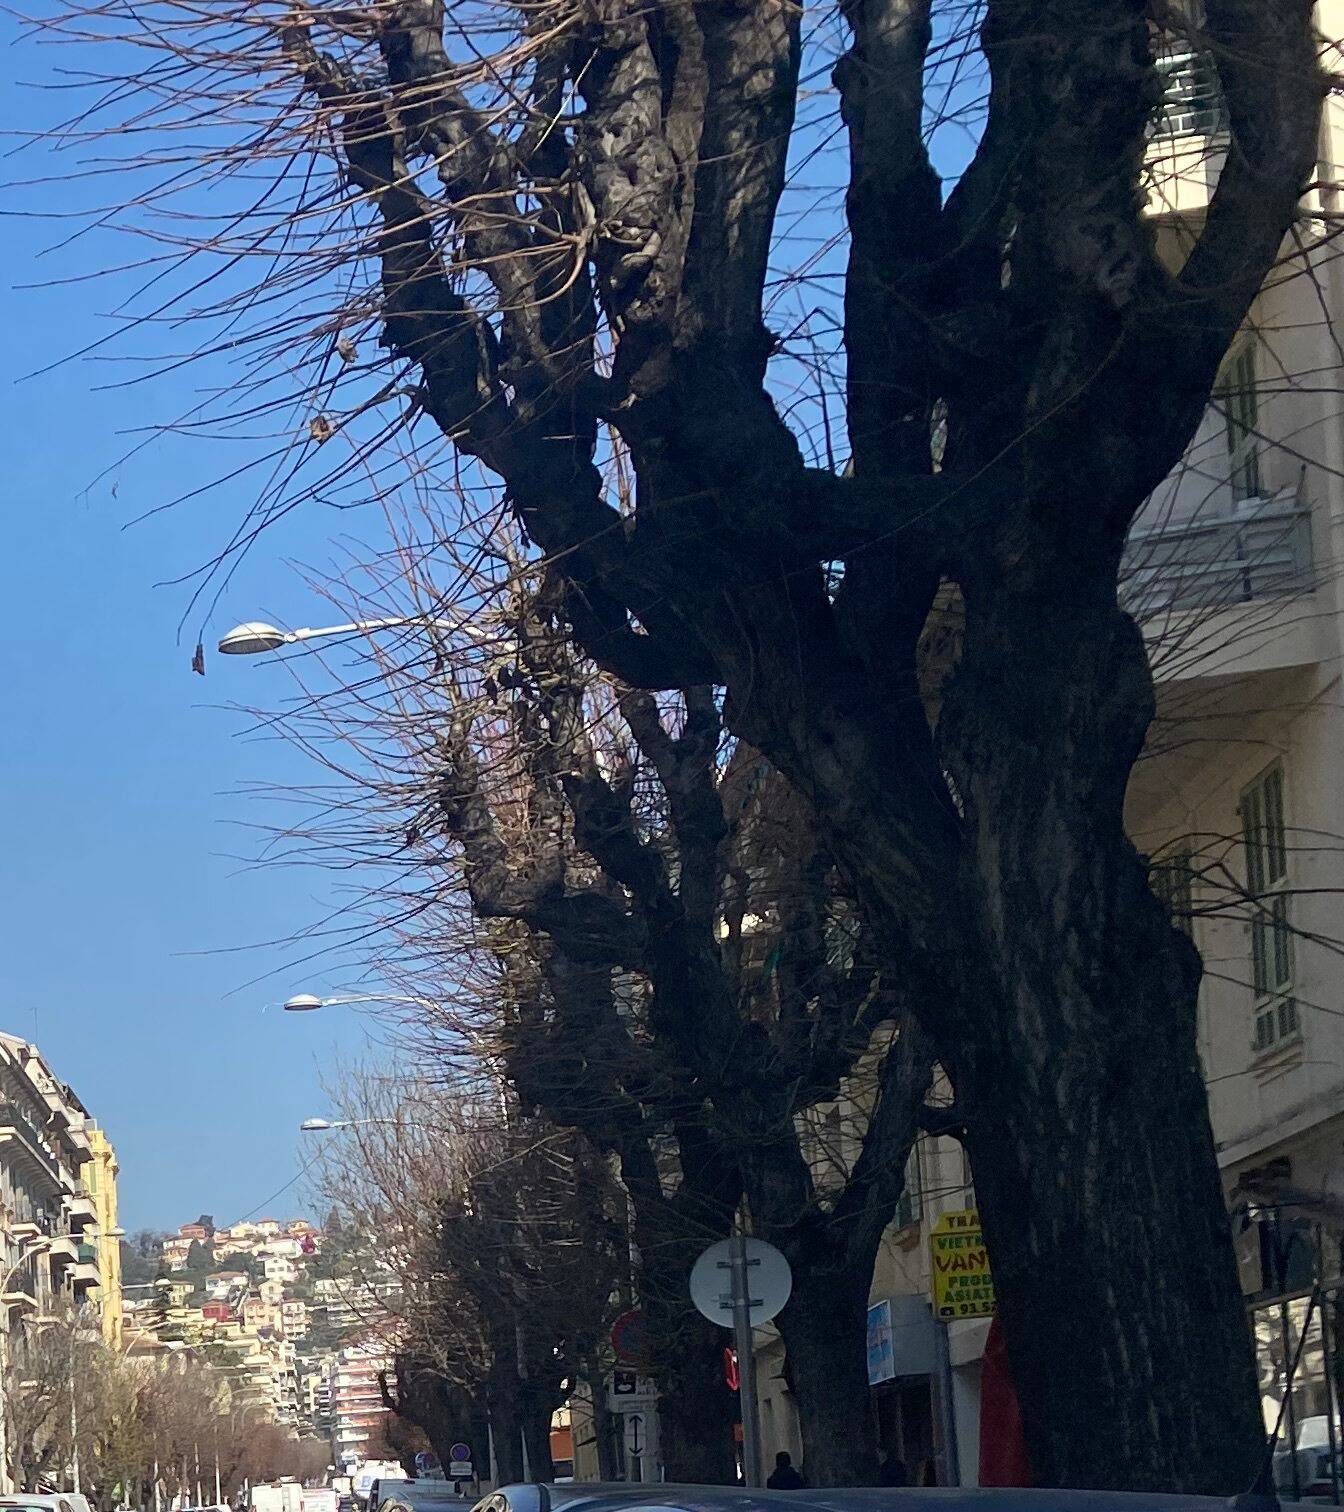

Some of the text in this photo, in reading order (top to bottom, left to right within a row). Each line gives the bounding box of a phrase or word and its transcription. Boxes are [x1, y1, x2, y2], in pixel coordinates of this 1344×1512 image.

[946, 1215, 981, 1228] TRA
[936, 1250, 987, 1272] VAN
[949, 1274, 992, 1288] PROD
[944, 1287, 991, 1302] ASIAT
